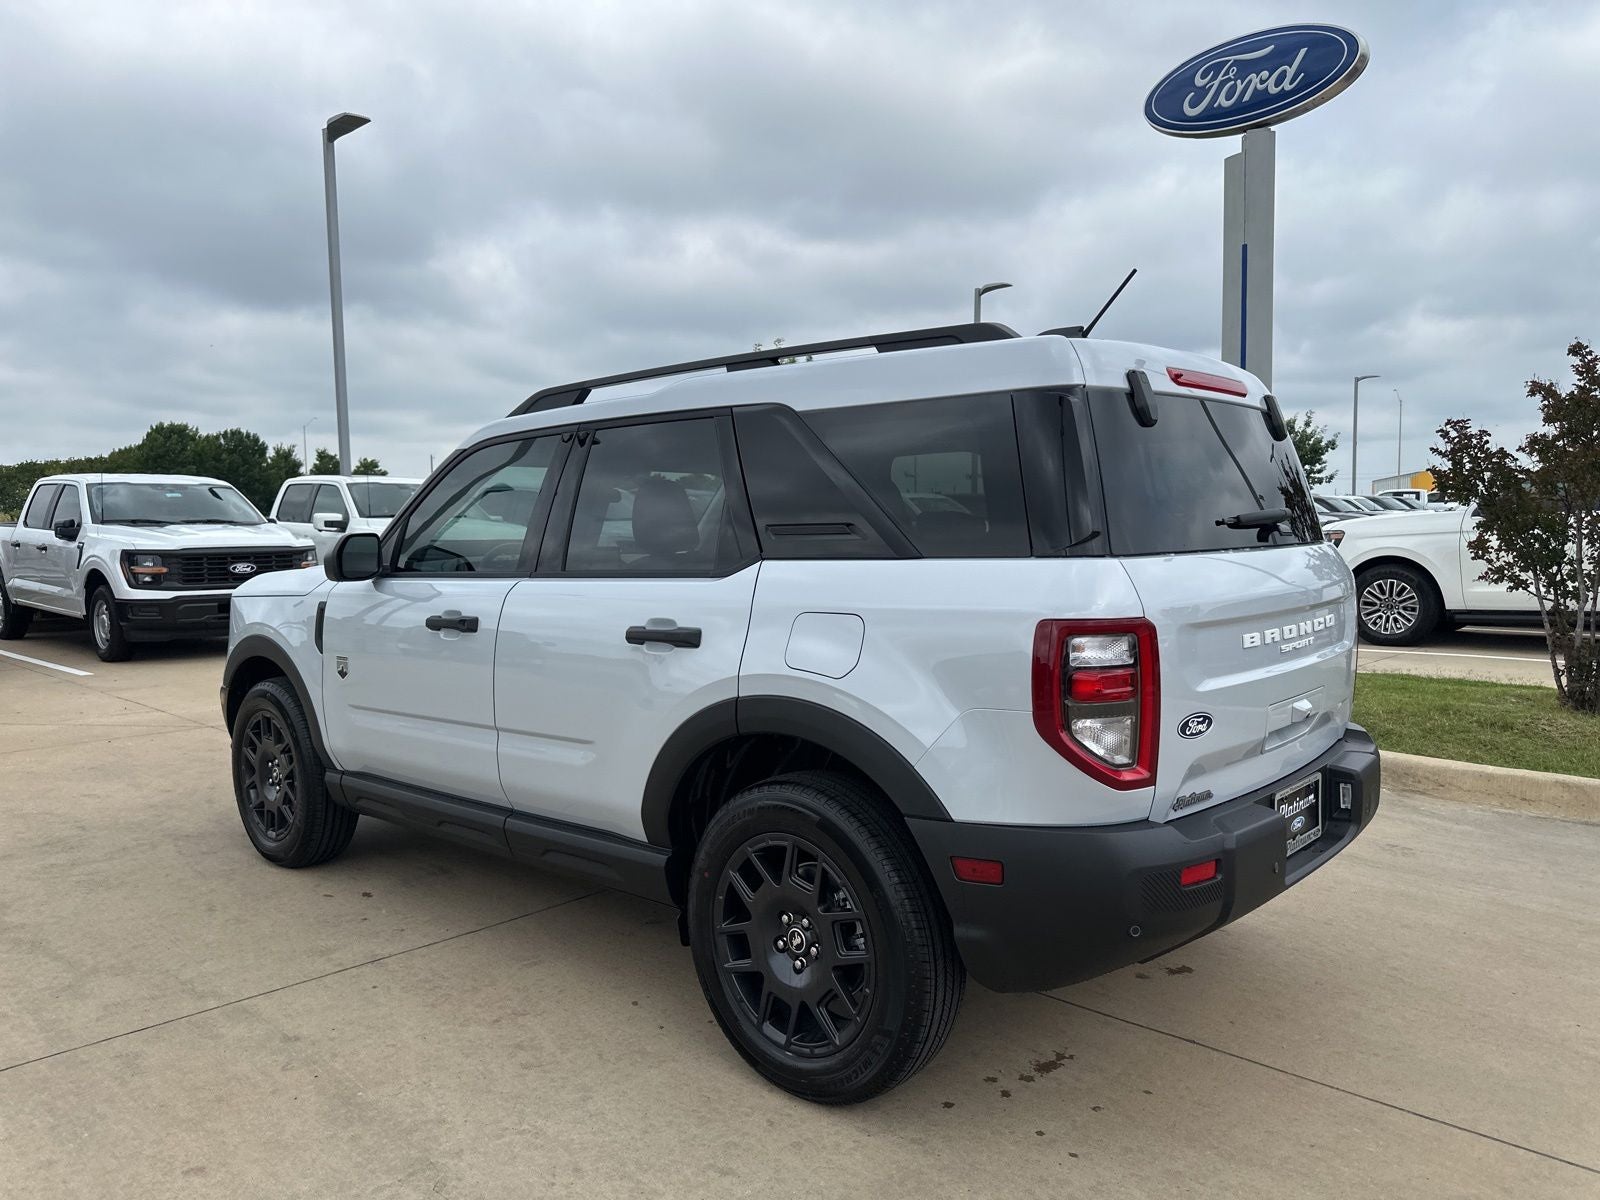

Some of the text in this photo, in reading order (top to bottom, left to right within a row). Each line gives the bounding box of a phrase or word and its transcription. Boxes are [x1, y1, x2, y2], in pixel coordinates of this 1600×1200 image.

[1183, 45, 1308, 117] Ford
[1242, 614, 1335, 649] BRONCO
[1280, 636, 1315, 653] SPORT
[1186, 717, 1209, 735] Ford
[1279, 793, 1316, 818] Platinum
